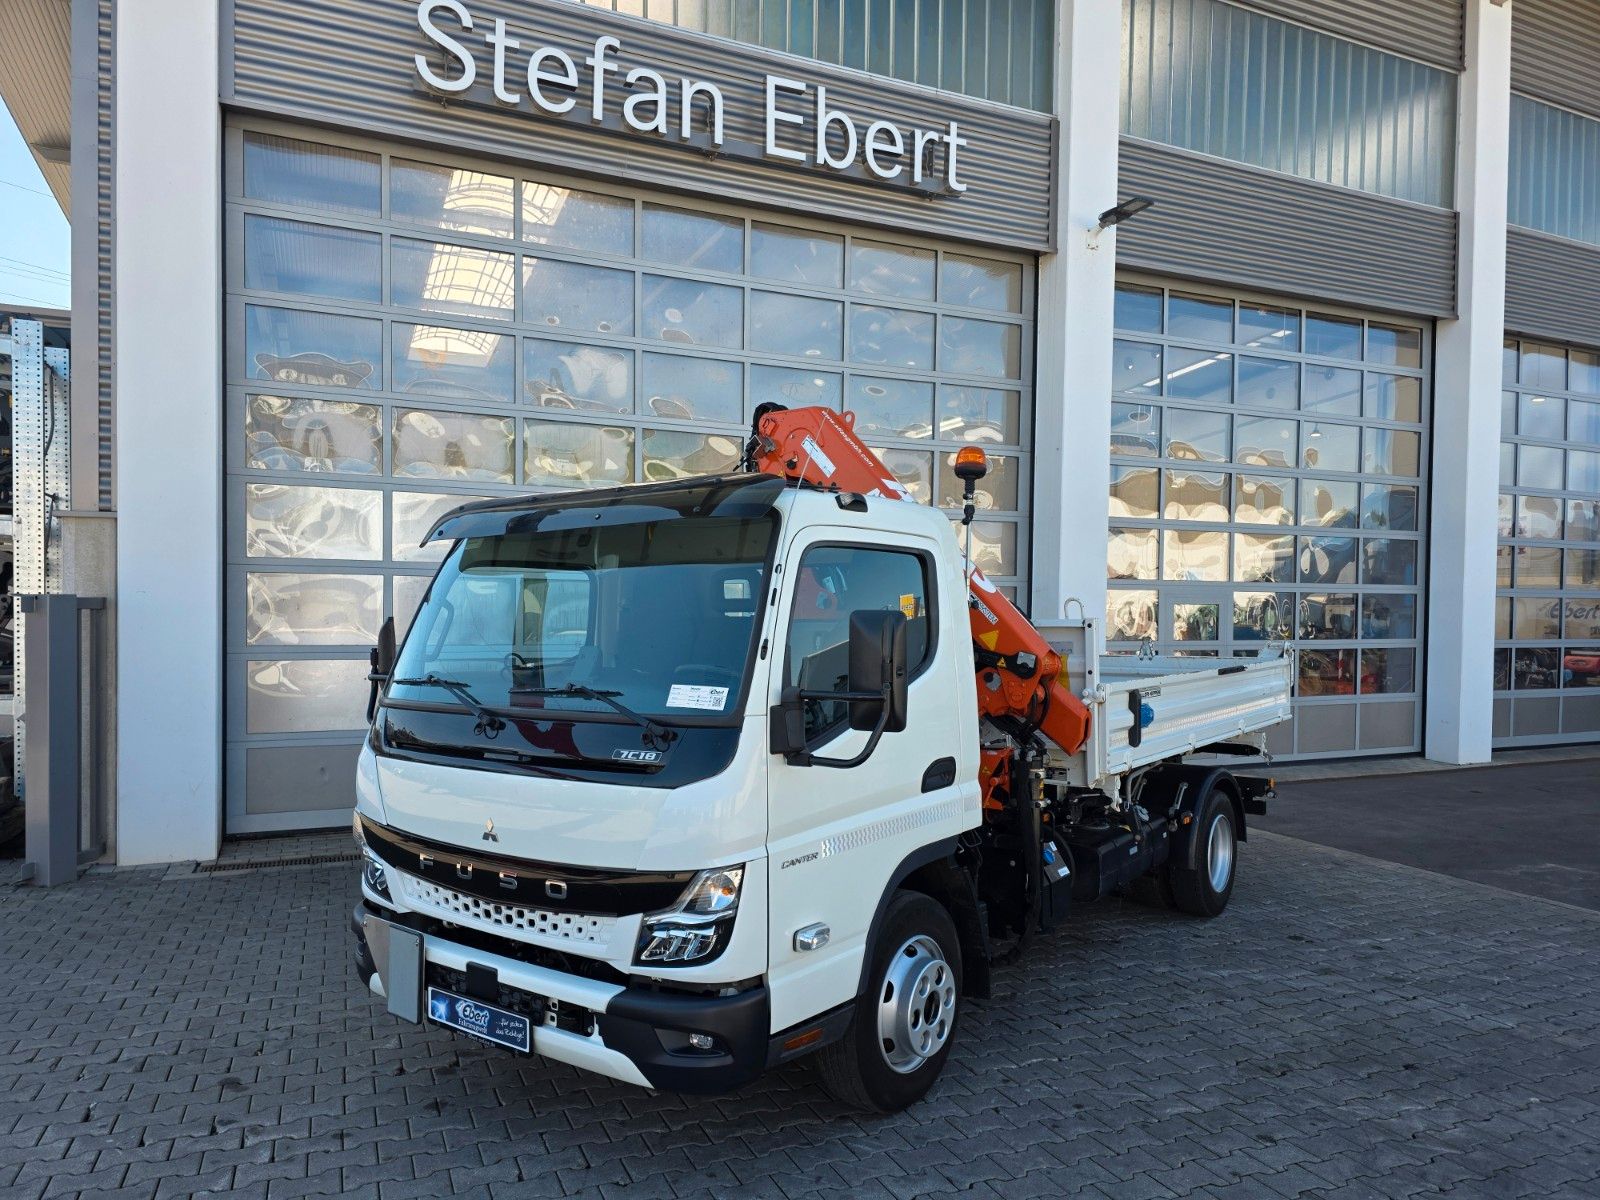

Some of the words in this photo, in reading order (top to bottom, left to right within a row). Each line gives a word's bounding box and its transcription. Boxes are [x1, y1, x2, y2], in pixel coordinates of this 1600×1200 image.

[414, 0, 724, 146] Stefan
[765, 74, 968, 192] Ebert
[620, 750, 657, 761] 7C18
[419, 852, 568, 900] FUSO
[780, 851, 819, 870] CANTER
